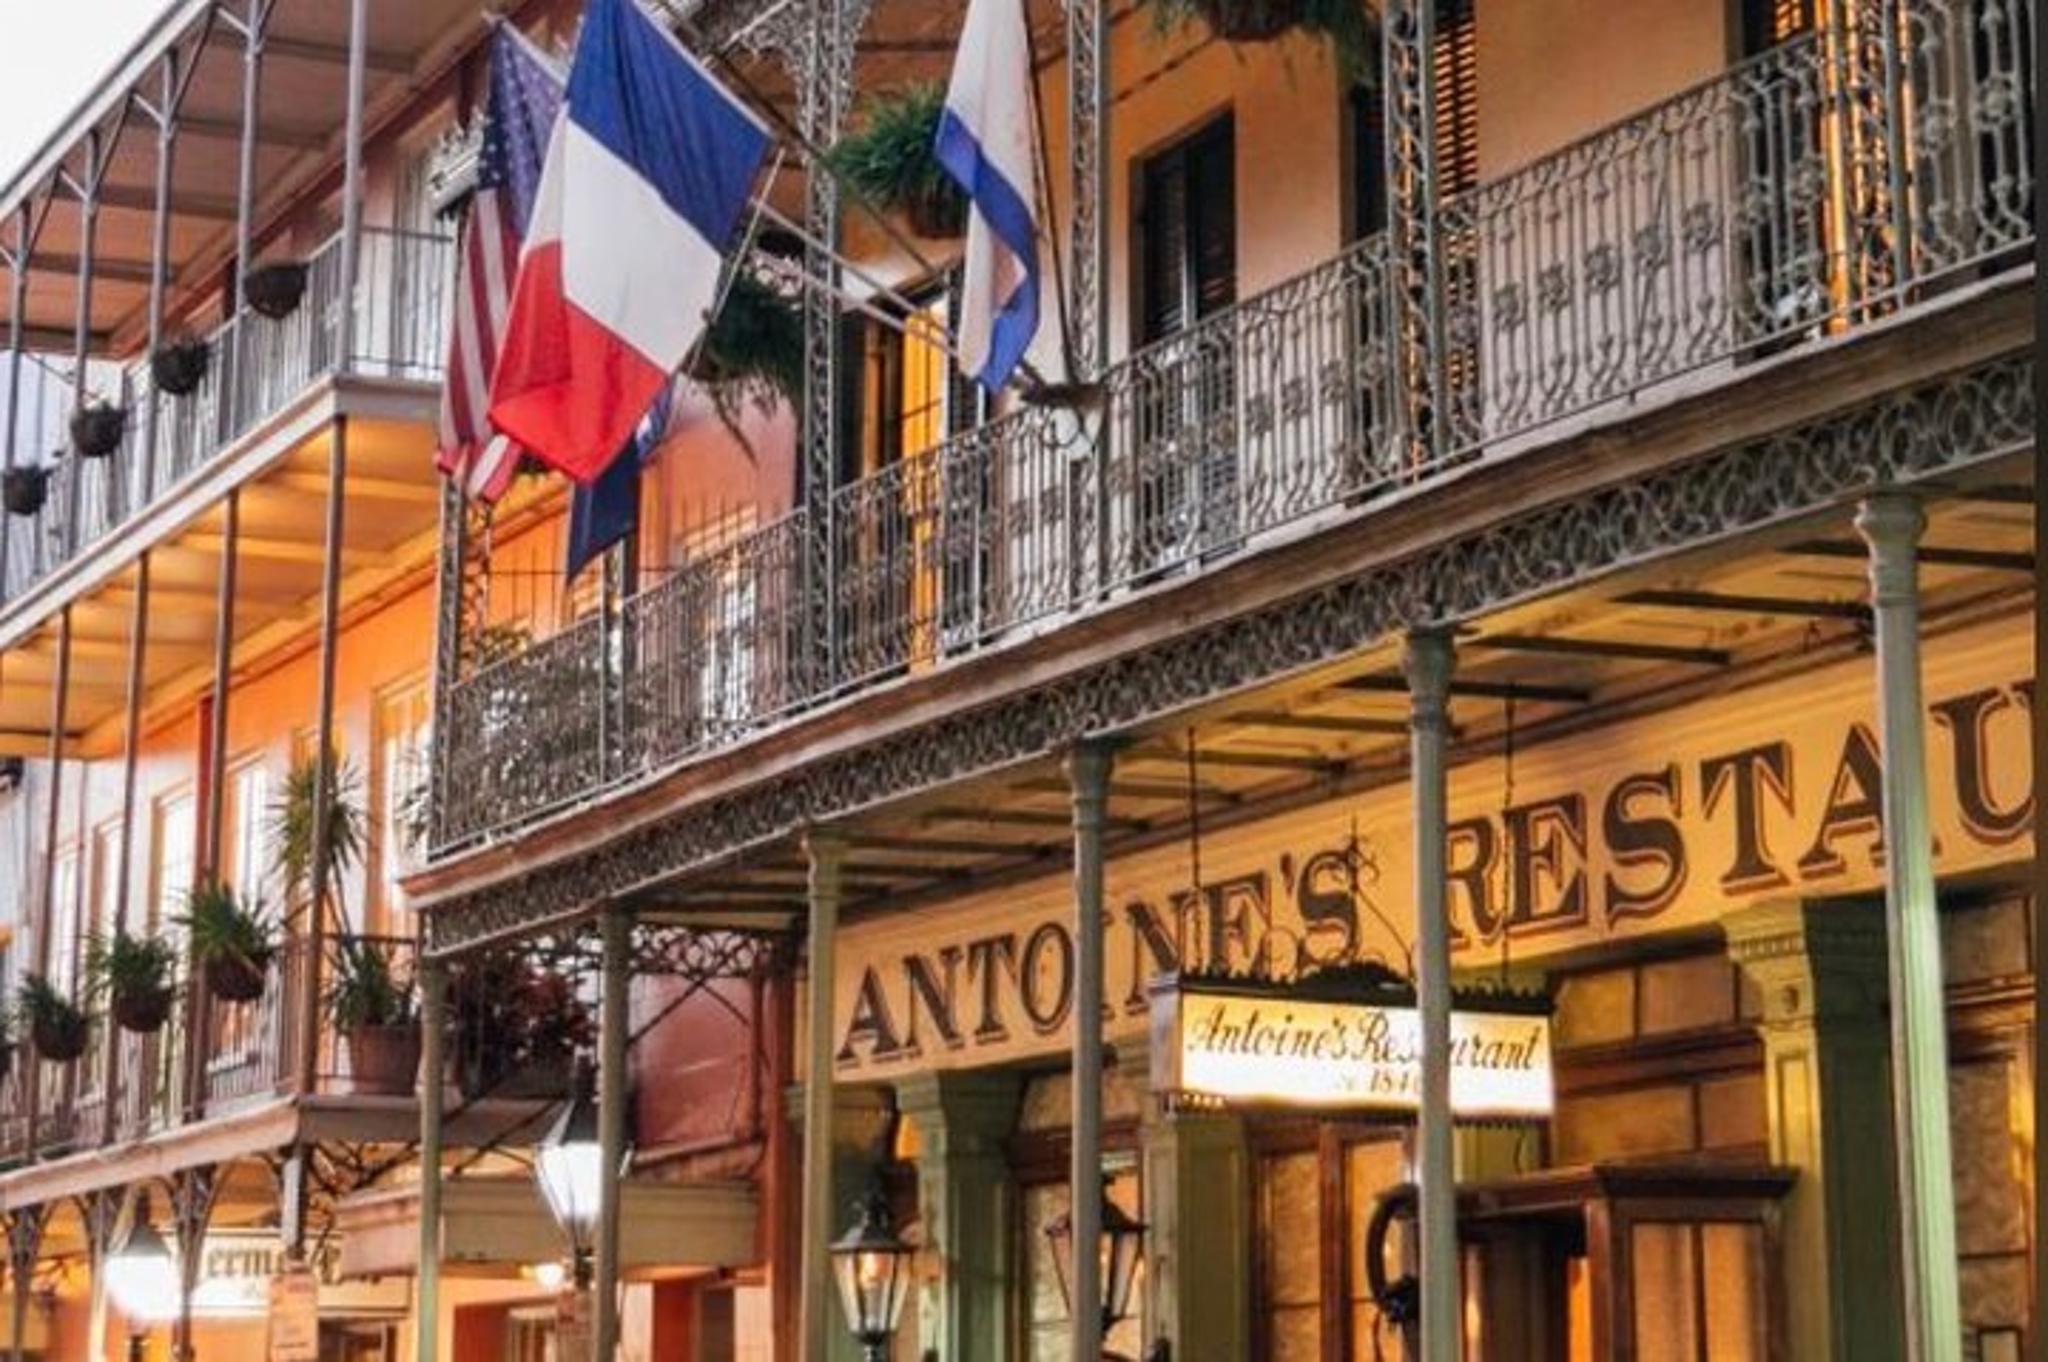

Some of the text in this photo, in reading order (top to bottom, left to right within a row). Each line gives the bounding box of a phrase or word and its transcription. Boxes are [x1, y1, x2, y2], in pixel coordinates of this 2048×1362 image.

[836, 850, 1360, 1071] ANTONE'S
[1187, 1002, 1542, 1071] Antoine's Resurant
